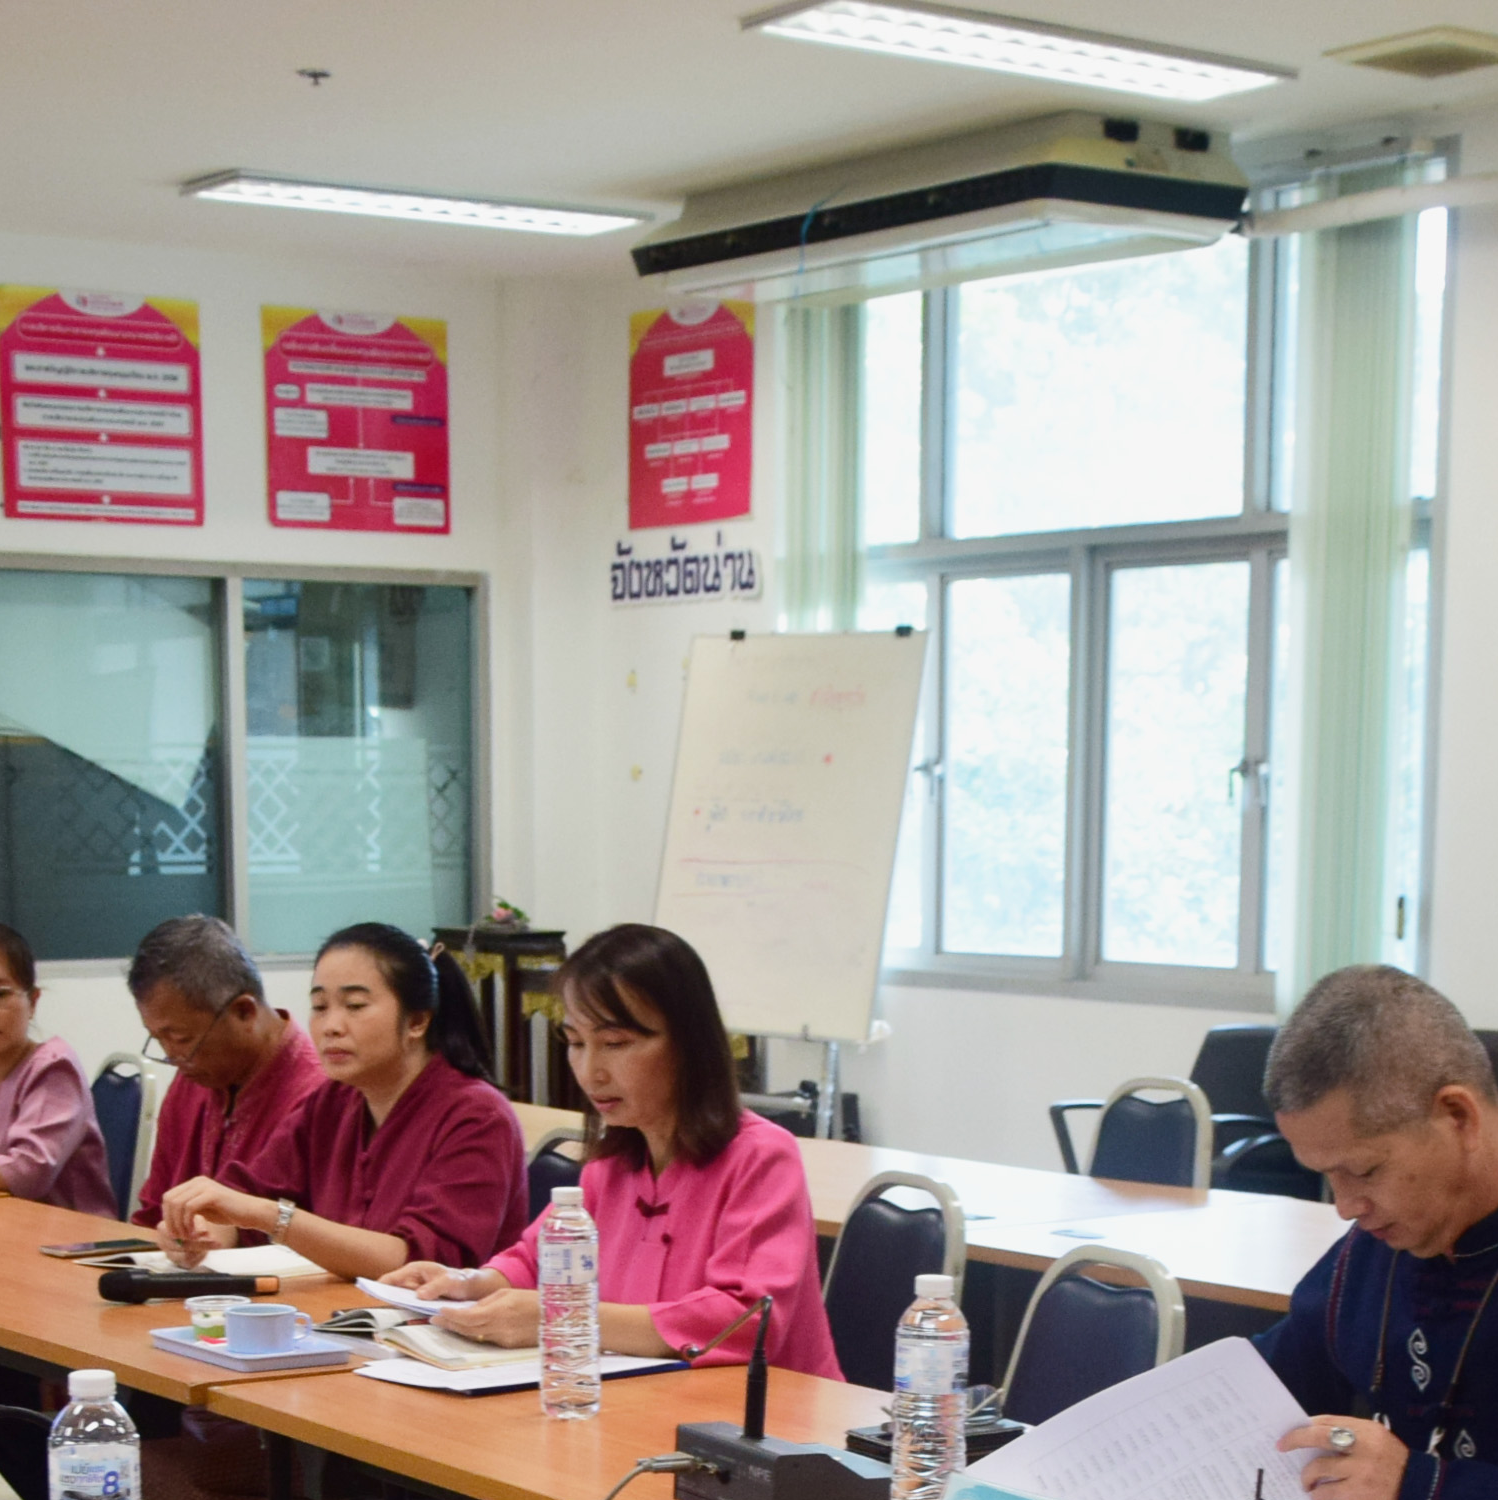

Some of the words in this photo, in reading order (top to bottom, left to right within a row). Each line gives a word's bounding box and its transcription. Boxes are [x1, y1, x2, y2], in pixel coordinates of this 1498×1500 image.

[610, 530, 756, 602] จังหวัดน่าน
[102, 1470, 120, 1496] 8
